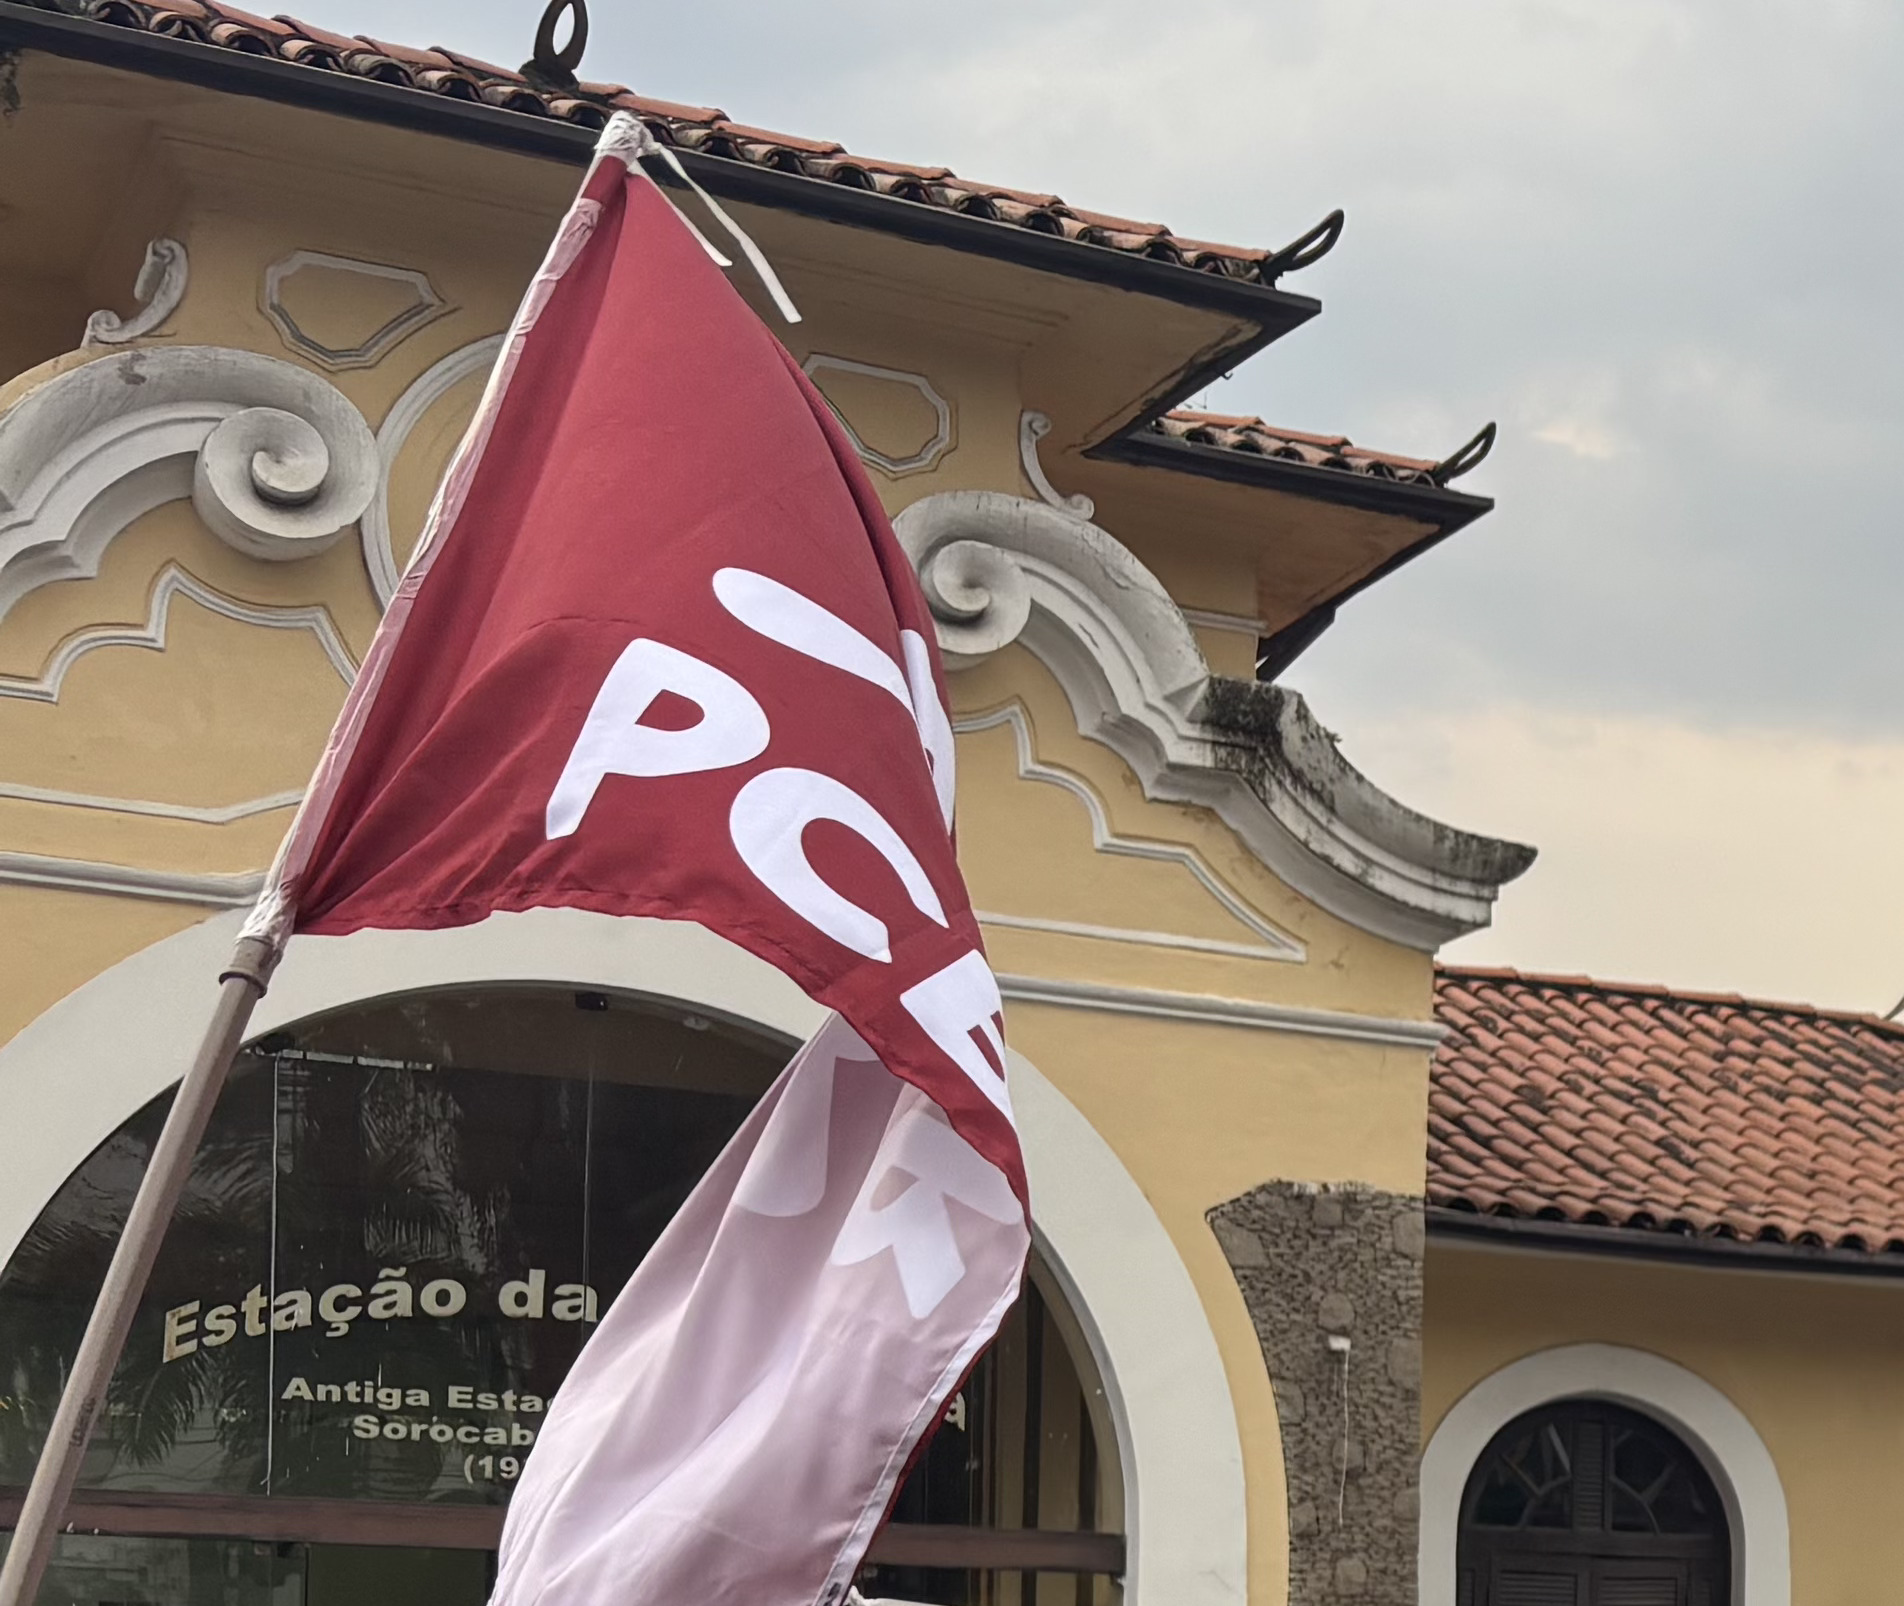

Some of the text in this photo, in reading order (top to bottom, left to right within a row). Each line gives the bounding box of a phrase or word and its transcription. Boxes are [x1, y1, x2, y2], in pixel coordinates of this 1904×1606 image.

[163, 1266, 598, 1363] Estação da
[282, 1377, 556, 1413] Antiga Esta
[353, 1415, 534, 1447] Sorocab
[463, 1456, 522, 1484] (19
